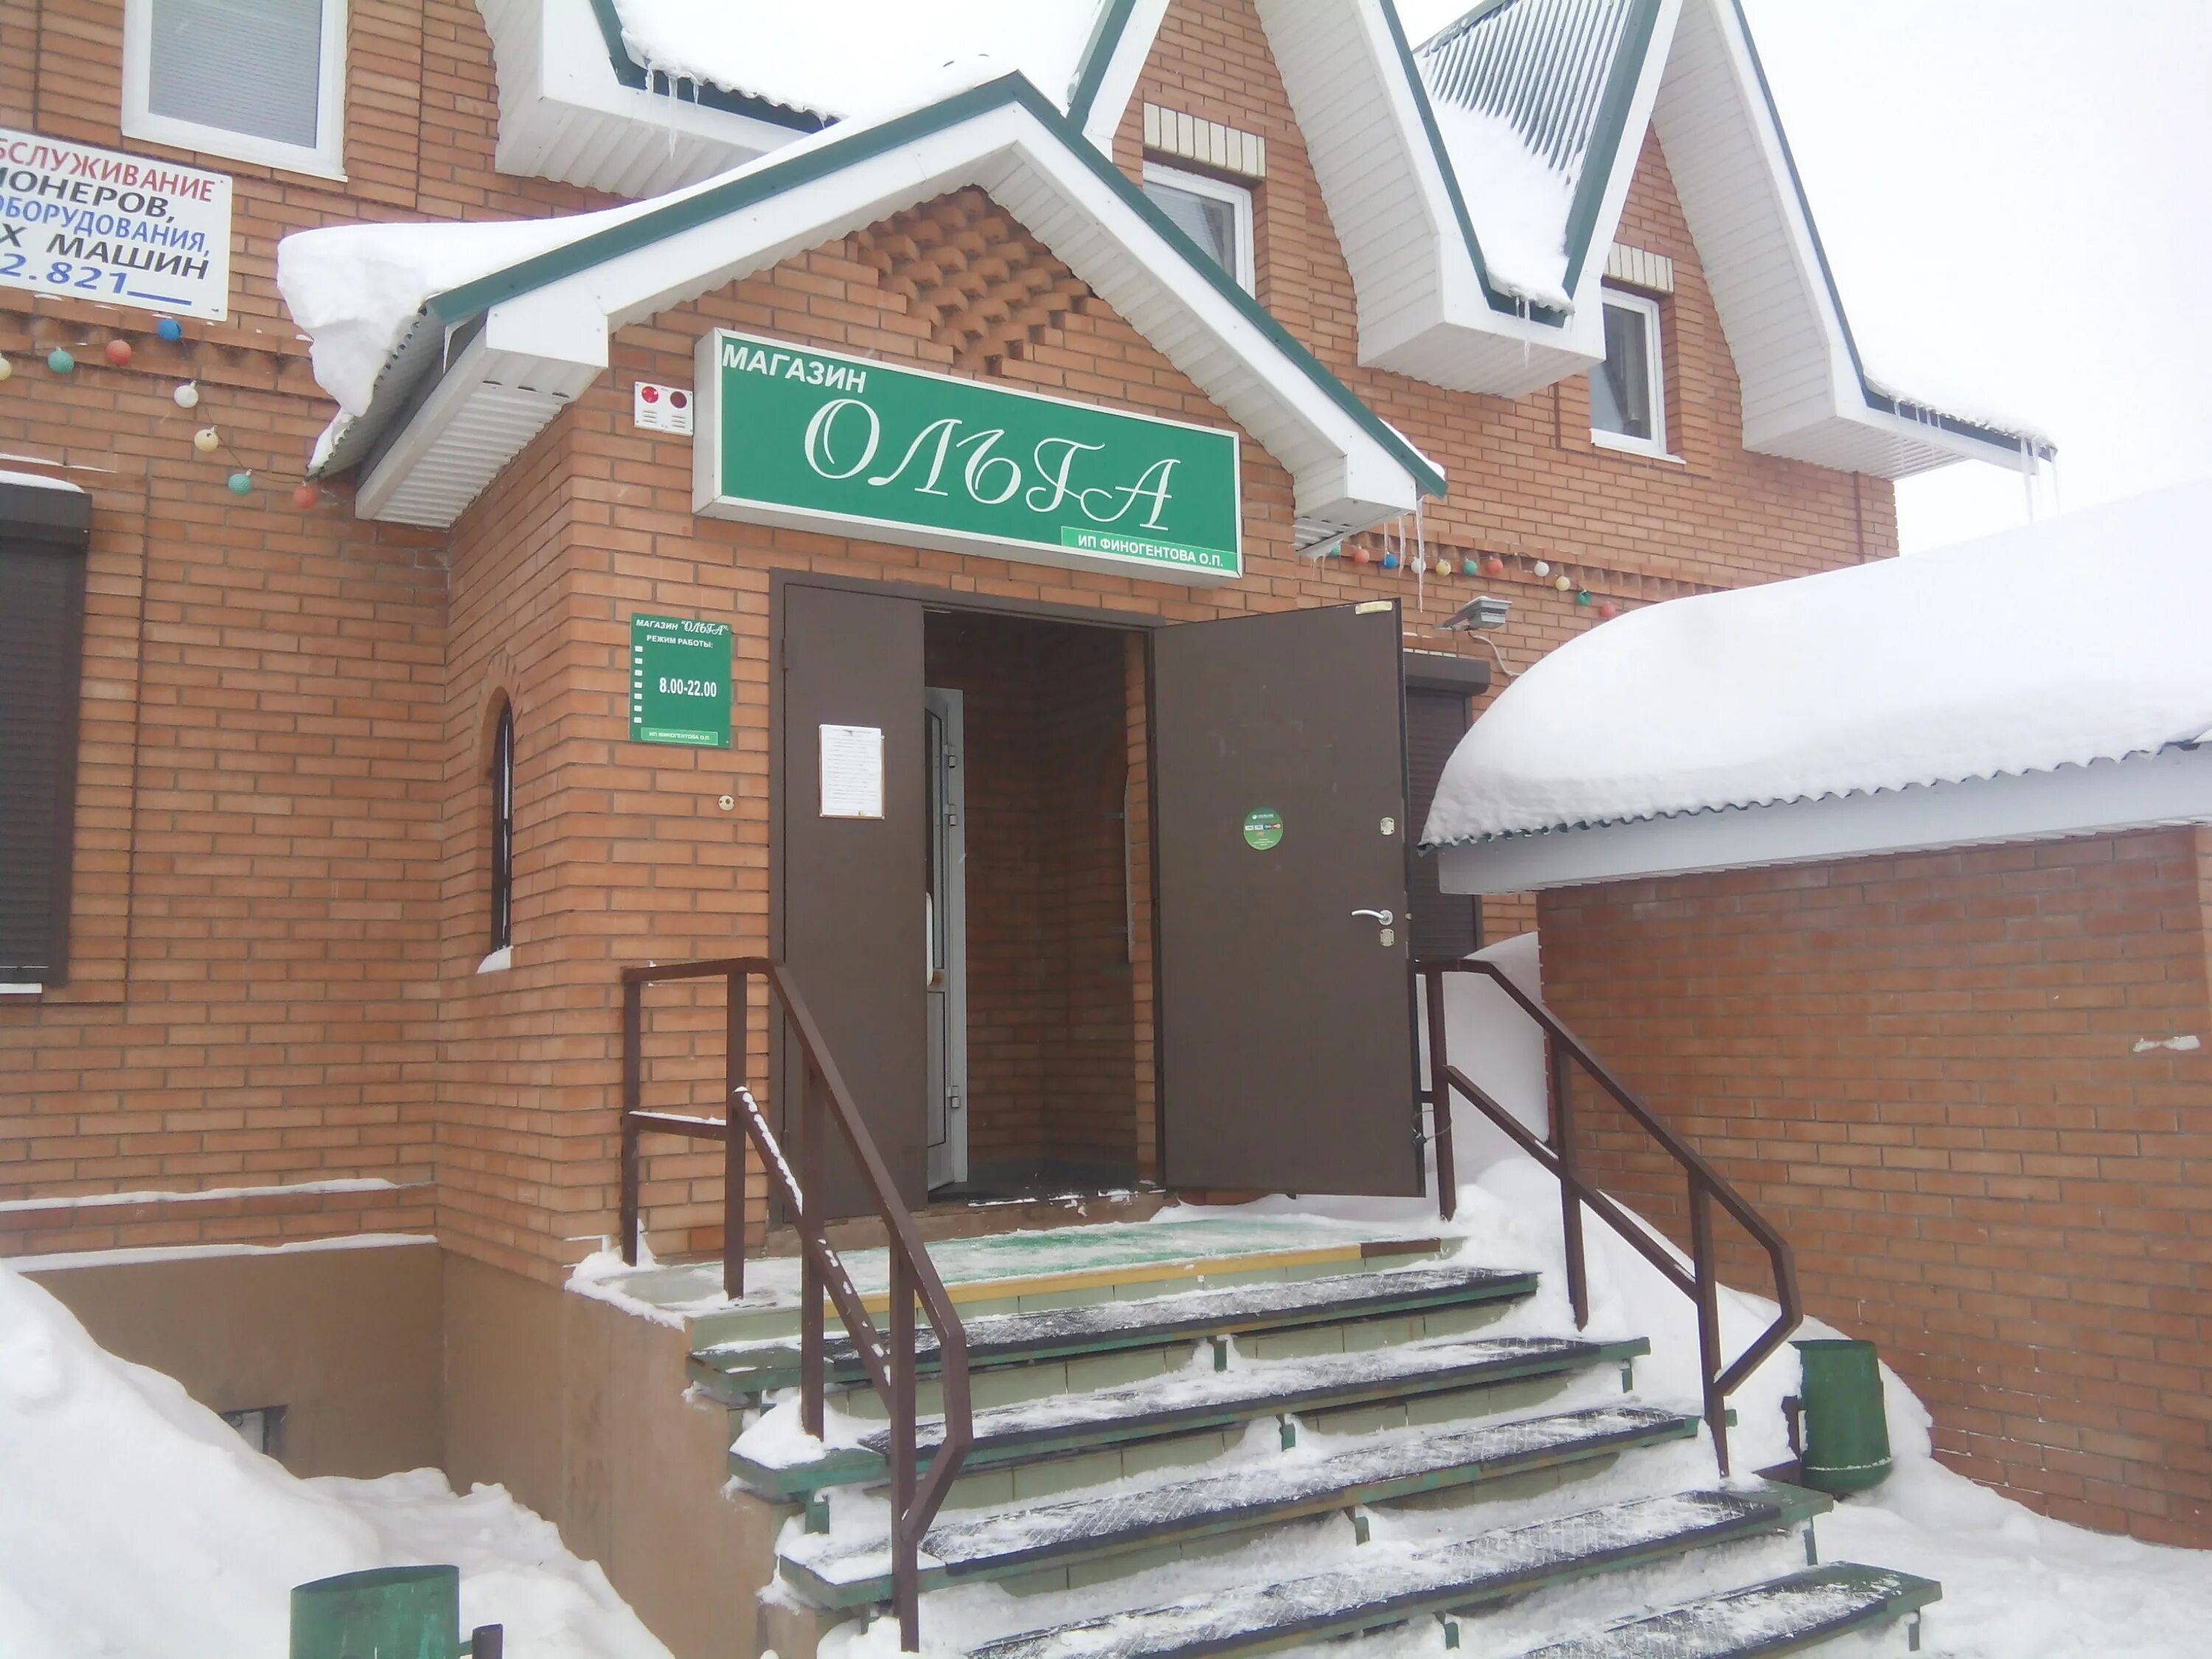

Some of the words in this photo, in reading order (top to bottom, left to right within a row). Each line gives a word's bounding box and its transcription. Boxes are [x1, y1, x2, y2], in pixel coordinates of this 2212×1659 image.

[0, 194, 210, 257] БОРУДОВАНИЯ,
[46, 233, 209, 279] МАШИН
[722, 344, 867, 393] МАГАЗИН
[804, 399, 1181, 531] ОЛЬГА
[1078, 535, 1096, 548] ИП
[1100, 538, 1196, 563] ФИНОГЕНТОВА
[1199, 553, 1224, 567] О.П.
[636, 619, 678, 630] МАГАЗИН
[647, 635, 676, 644] РЕЖИМ
[678, 639, 714, 648] РАБОТЫ:
[659, 677, 717, 697] 8.00-22.00
